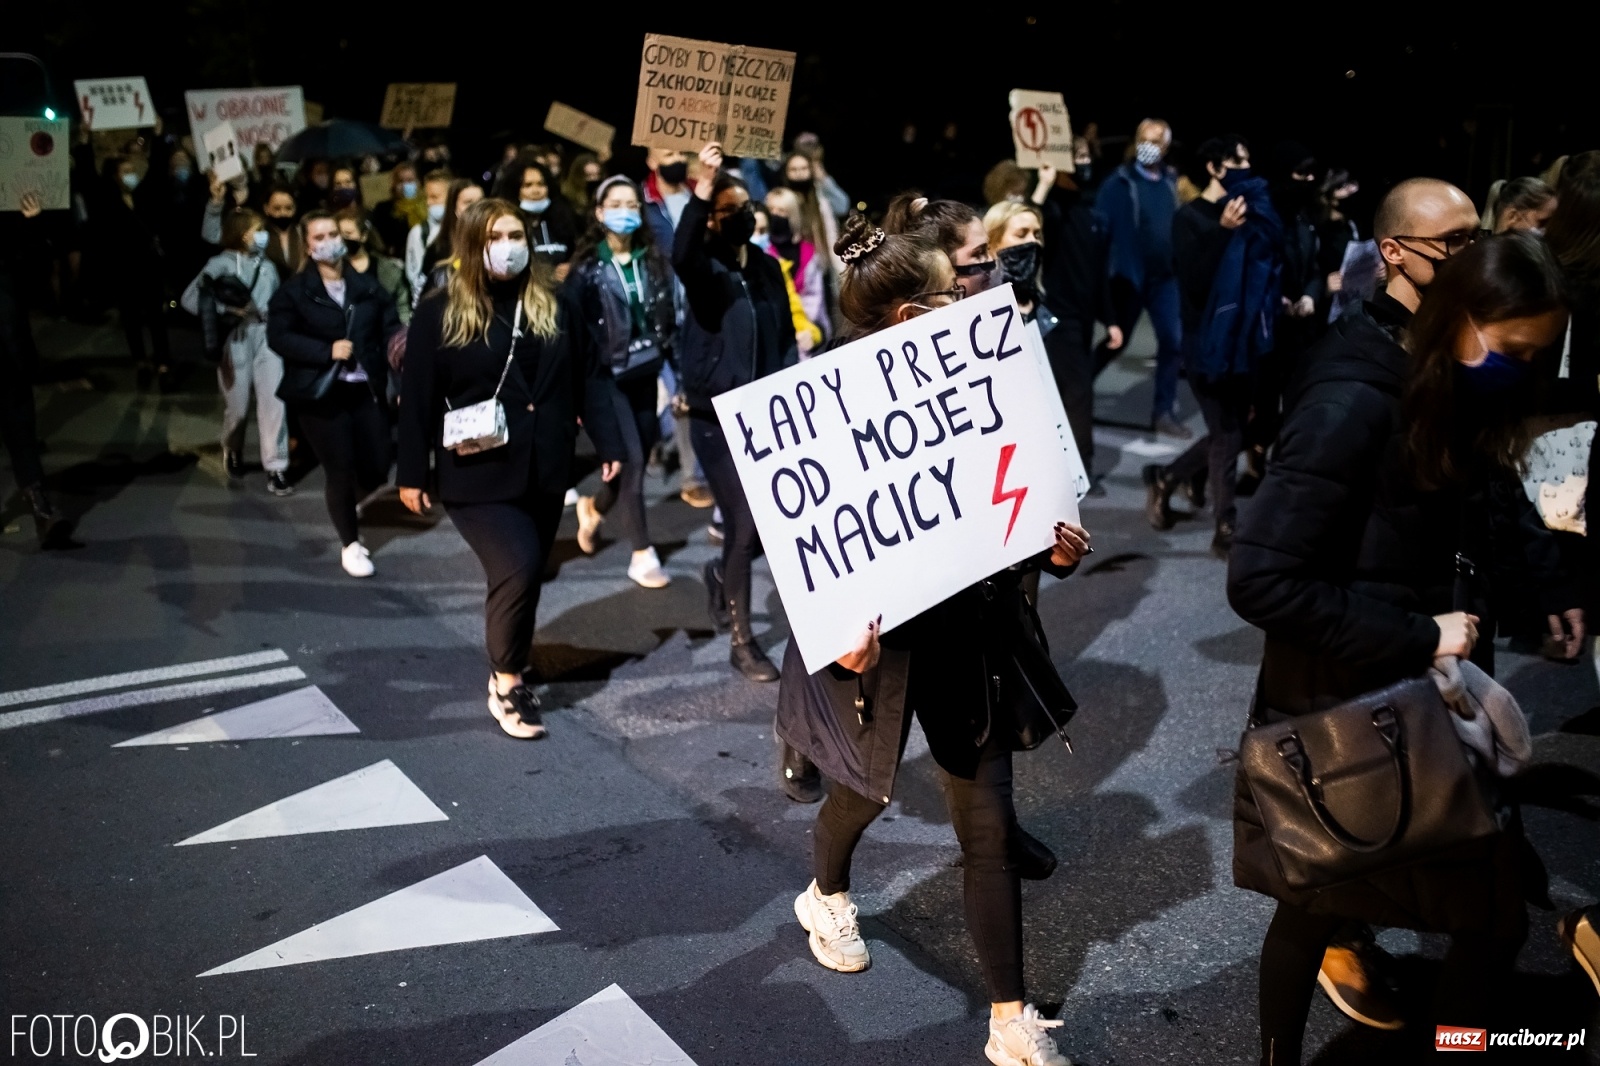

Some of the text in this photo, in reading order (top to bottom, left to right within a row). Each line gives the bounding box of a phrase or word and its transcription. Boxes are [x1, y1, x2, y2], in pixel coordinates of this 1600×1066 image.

[644, 44, 692, 69] GDYBY
[697, 50, 716, 73] TO
[645, 70, 732, 96] ZACHODZILI
[734, 83, 744, 97] W
[657, 95, 675, 110] TO
[735, 304, 1023, 462] ŁAPY PRECZ
[771, 375, 1004, 519] OD MOJEJ
[795, 457, 963, 592] MACICY
